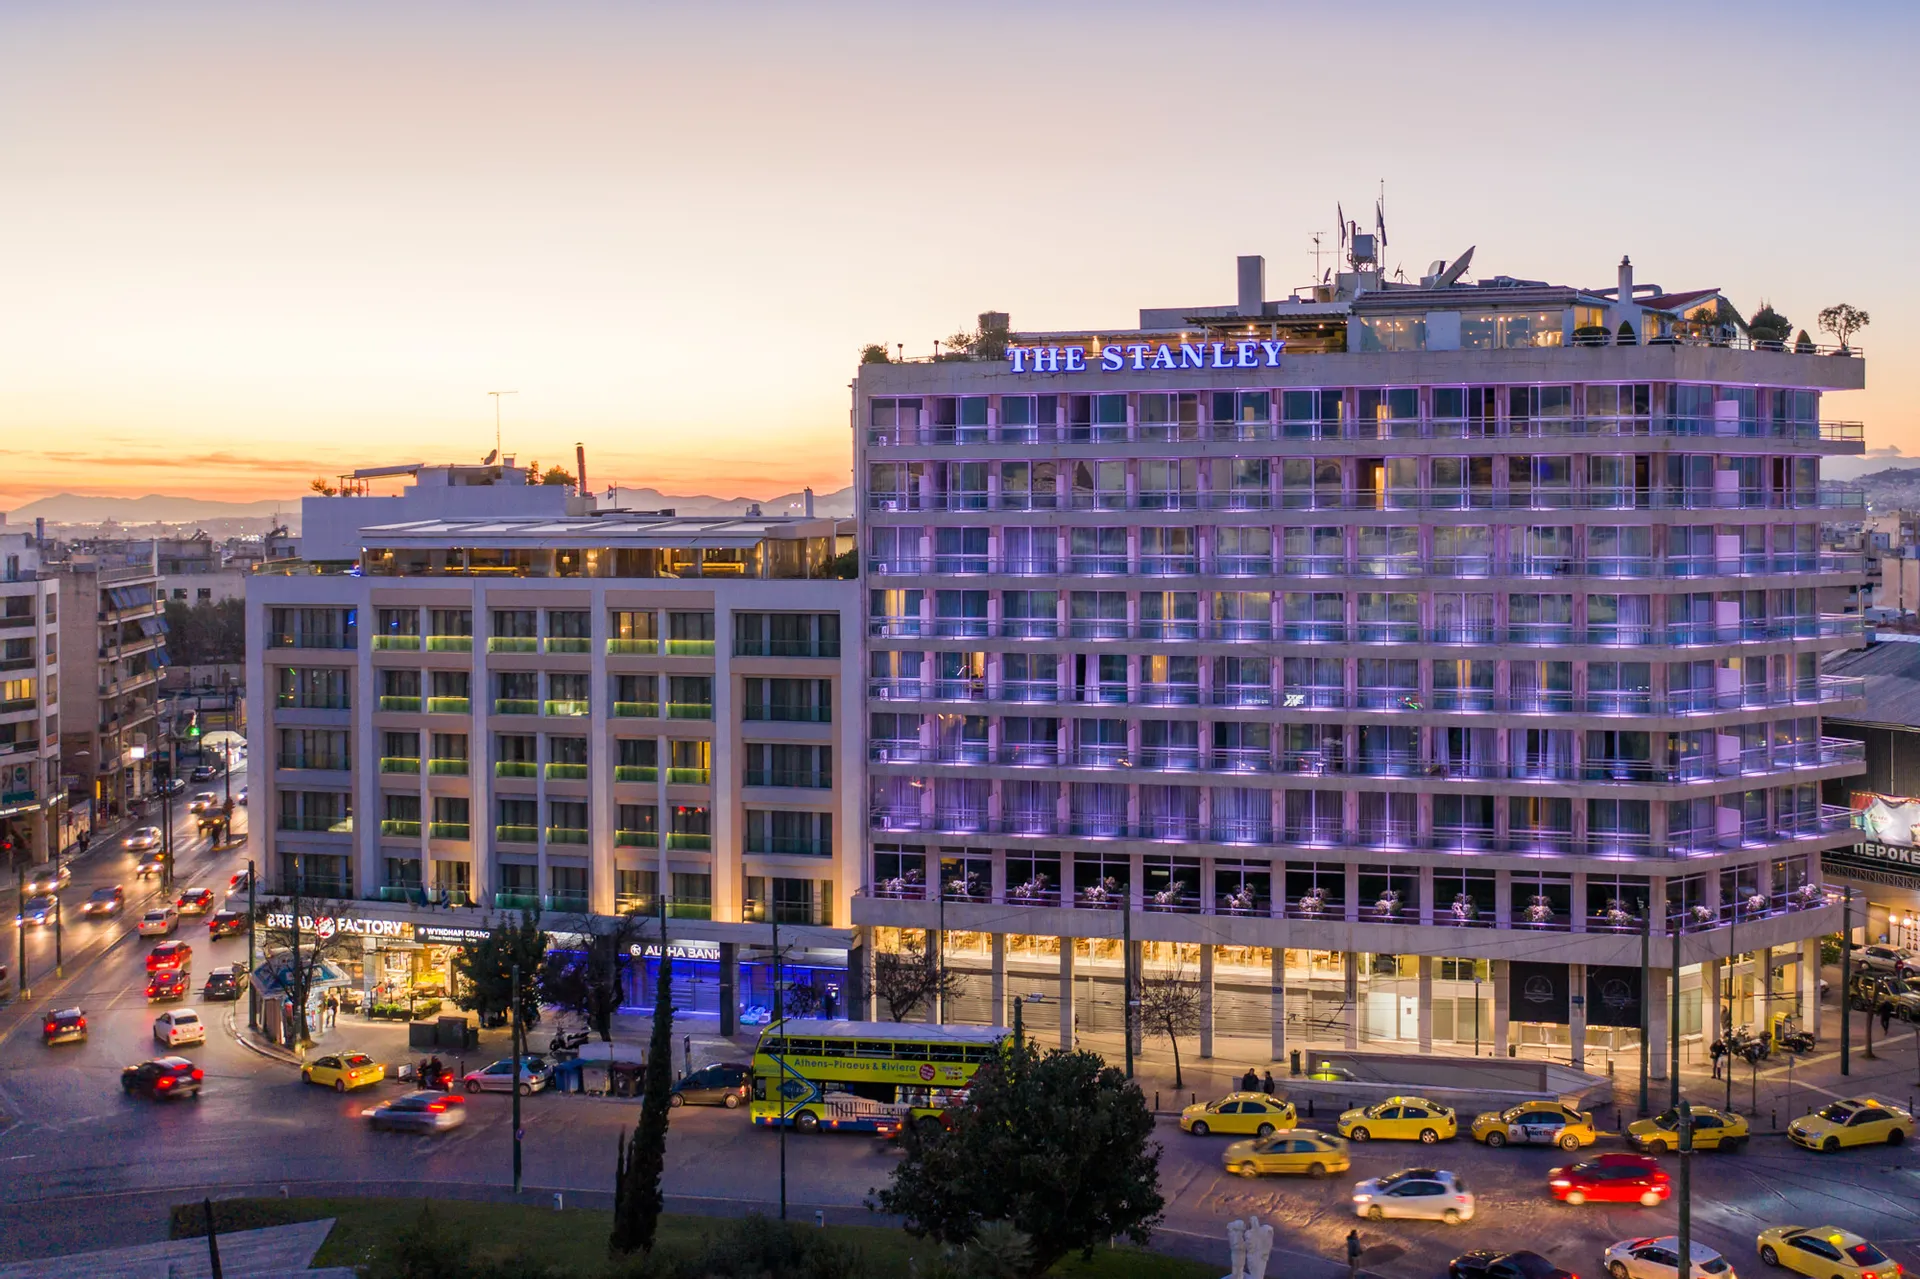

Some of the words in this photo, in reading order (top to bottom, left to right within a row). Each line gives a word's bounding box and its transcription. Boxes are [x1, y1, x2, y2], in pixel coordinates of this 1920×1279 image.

[1006, 346, 1086, 373] THE
[1101, 341, 1285, 371] STANLEY
[337, 918, 403, 935] FACTORY
[426, 927, 464, 937] WYNDHAM
[644, 944, 686, 958] ALHA
[687, 947, 720, 960] BANK
[881, 1062, 916, 1072] Riviera
